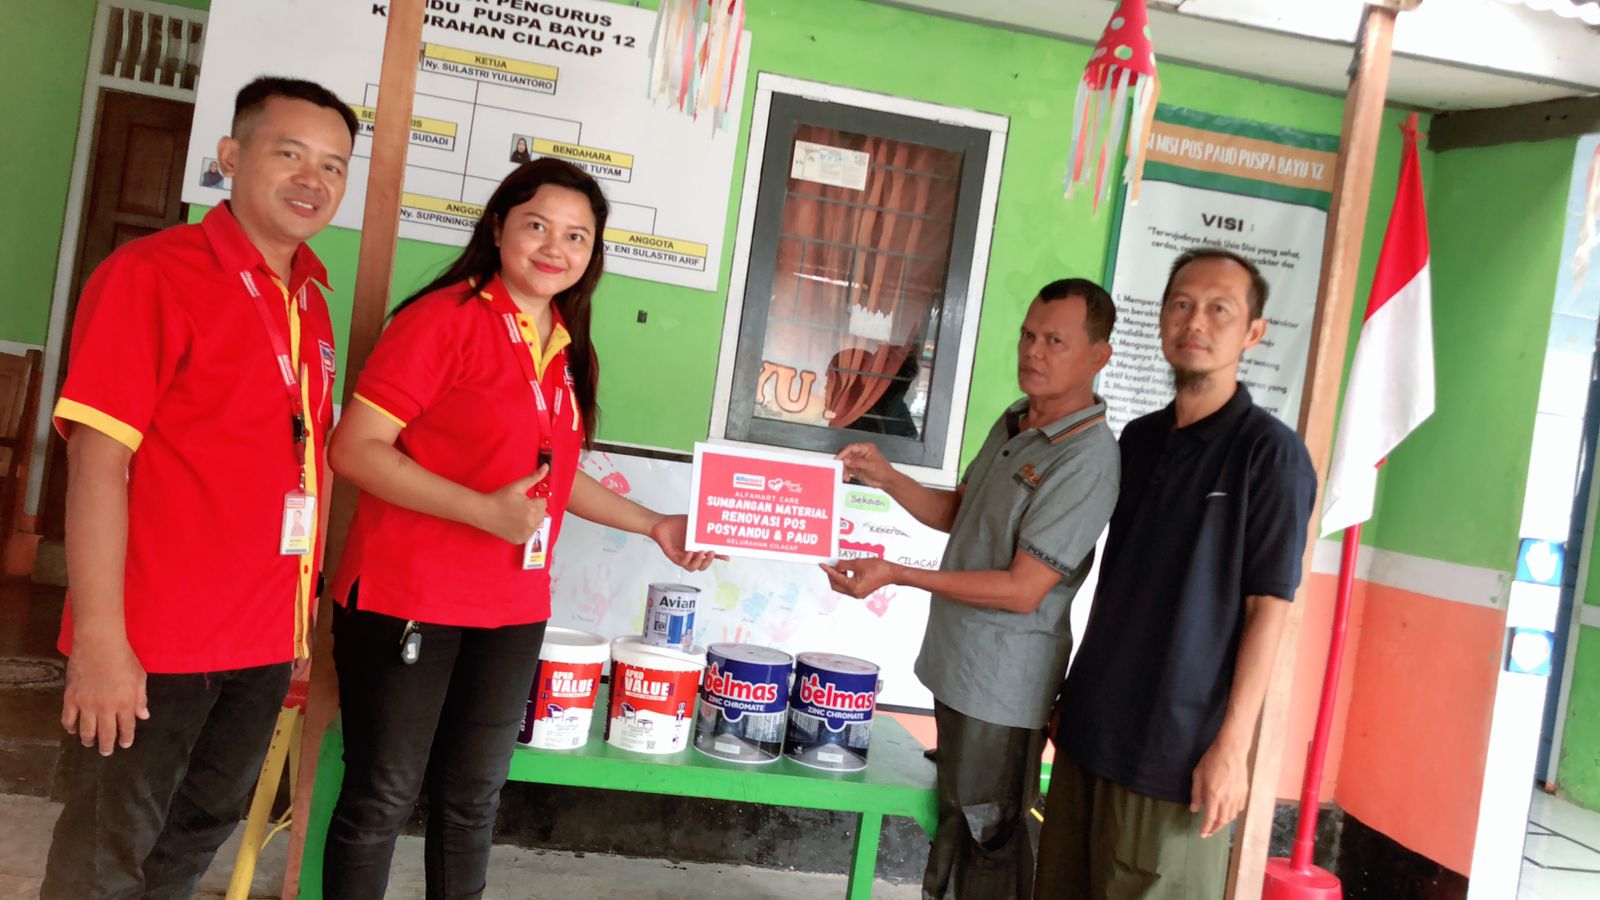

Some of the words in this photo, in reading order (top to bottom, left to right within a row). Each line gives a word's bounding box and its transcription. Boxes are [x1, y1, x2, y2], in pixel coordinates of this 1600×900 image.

[497, 0, 612, 27] PENGURUS
[474, 7, 541, 31] PUSPA
[549, 22, 604, 42] BAYU
[612, 35, 636, 48] 12
[512, 32, 602, 56] CILACAP
[475, 56, 507, 69] KETUA
[425, 60, 439, 69] Ny.
[442, 62, 489, 78] SULASTRI
[492, 73, 552, 90] YULIANTORO
[411, 132, 448, 145] SUDADI
[553, 145, 611, 162] BENDAHARA
[1156, 135, 1178, 156] MISI
[1204, 142, 1237, 165] PAUD
[1238, 148, 1276, 173] PUSPA
[1277, 156, 1308, 178] BAYU
[590, 165, 622, 176] TUYAM
[445, 203, 482, 216] ANGGO
[416, 211, 477, 227] SUPRININGS
[1201, 213, 1244, 232] VISI
[629, 235, 674, 249] ANGGOTA
[615, 245, 630, 254] ENI
[632, 248, 677, 262] SULASTRI
[735, 491, 776, 502] ALFAMART
[779, 496, 799, 504] CARE
[706, 496, 772, 513] SUMBANGAN
[776, 504, 828, 519] MATERIAL
[721, 510, 779, 527] RENOVASI
[784, 517, 807, 530] POS
[707, 522, 770, 539] POSYANDU
[773, 530, 783, 541] &
[787, 531, 818, 545] PAUD
[727, 538, 768, 548] KELURAHAN
[770, 543, 798, 551] CILACAP
[659, 596, 696, 608] Avian
[552, 678, 594, 693] VALUE
[625, 676, 670, 696] VALUE
[704, 664, 778, 703] belmas
[800, 674, 874, 711] belmas
[708, 695, 722, 706] ZINC
[724, 700, 765, 712] CHROMATE
[808, 706, 825, 717] ZINC
[826, 709, 865, 720] CHROMATE
